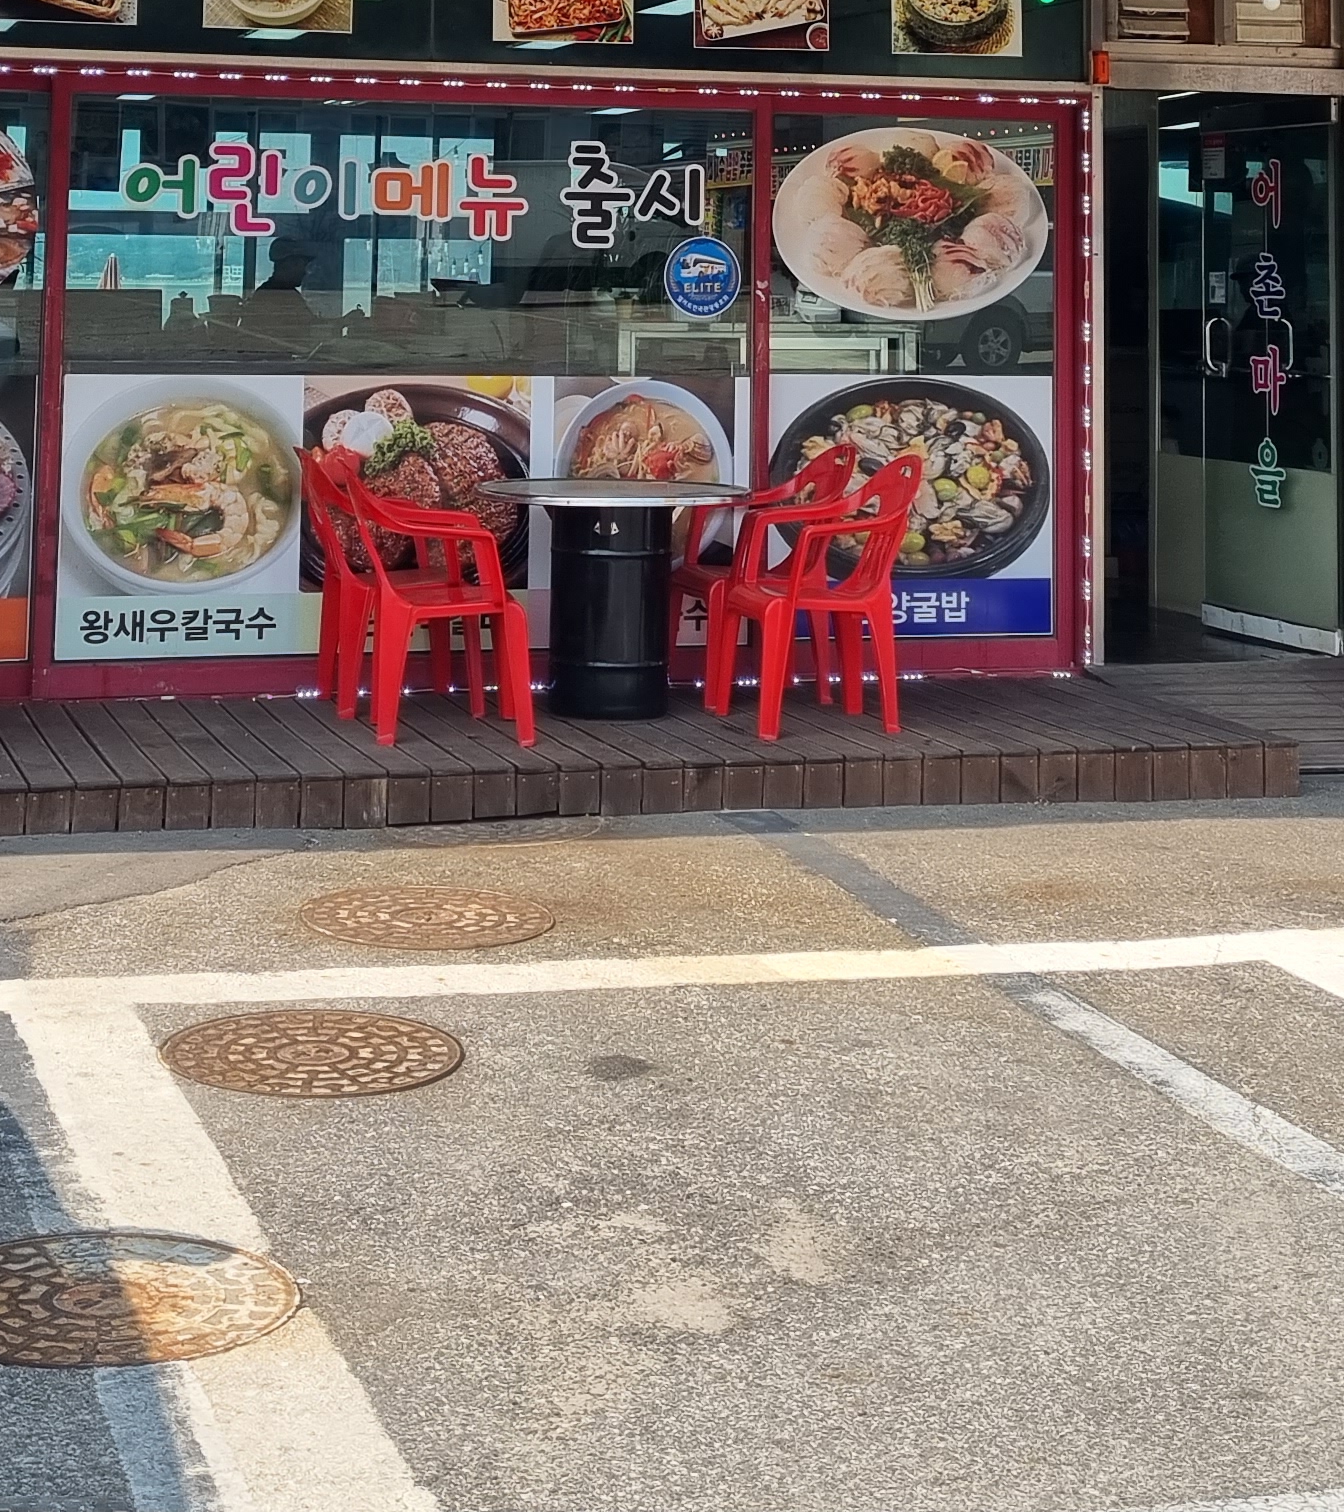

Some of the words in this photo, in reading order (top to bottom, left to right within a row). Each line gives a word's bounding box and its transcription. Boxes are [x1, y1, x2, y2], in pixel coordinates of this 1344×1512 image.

[559, 140, 706, 248] 출시
[684, 282, 722, 293] ELITE
[1249, 158, 1287, 509] 어촌마을
[79, 608, 278, 647] 왕새우칼국수
[862, 591, 970, 625] 양굴밥
